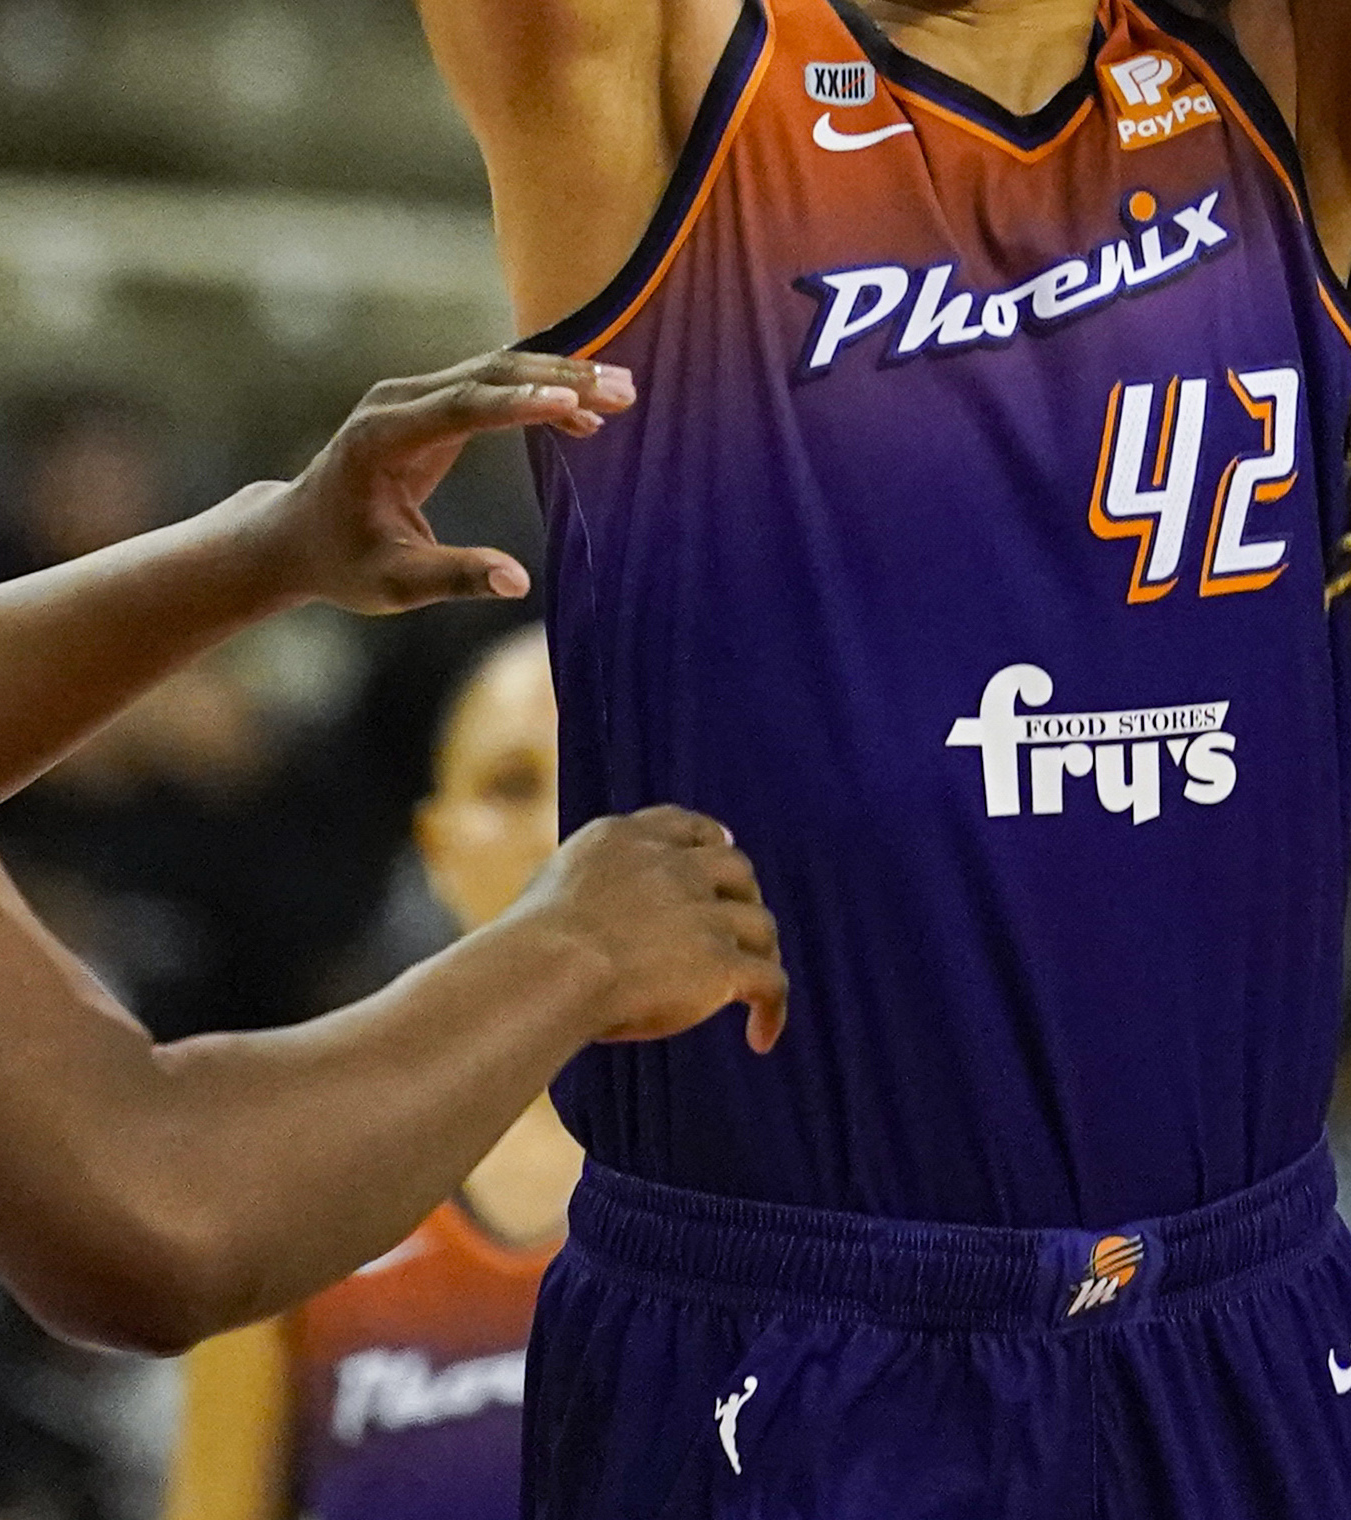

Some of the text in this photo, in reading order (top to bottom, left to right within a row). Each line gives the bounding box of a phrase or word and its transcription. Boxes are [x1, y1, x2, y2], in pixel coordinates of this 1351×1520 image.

[803, 189, 1229, 370] Phoenix
[1088, 367, 1299, 604] 42
[946, 663, 1237, 826] fry's
[1024, 707, 1217, 739] FOOD STORES
